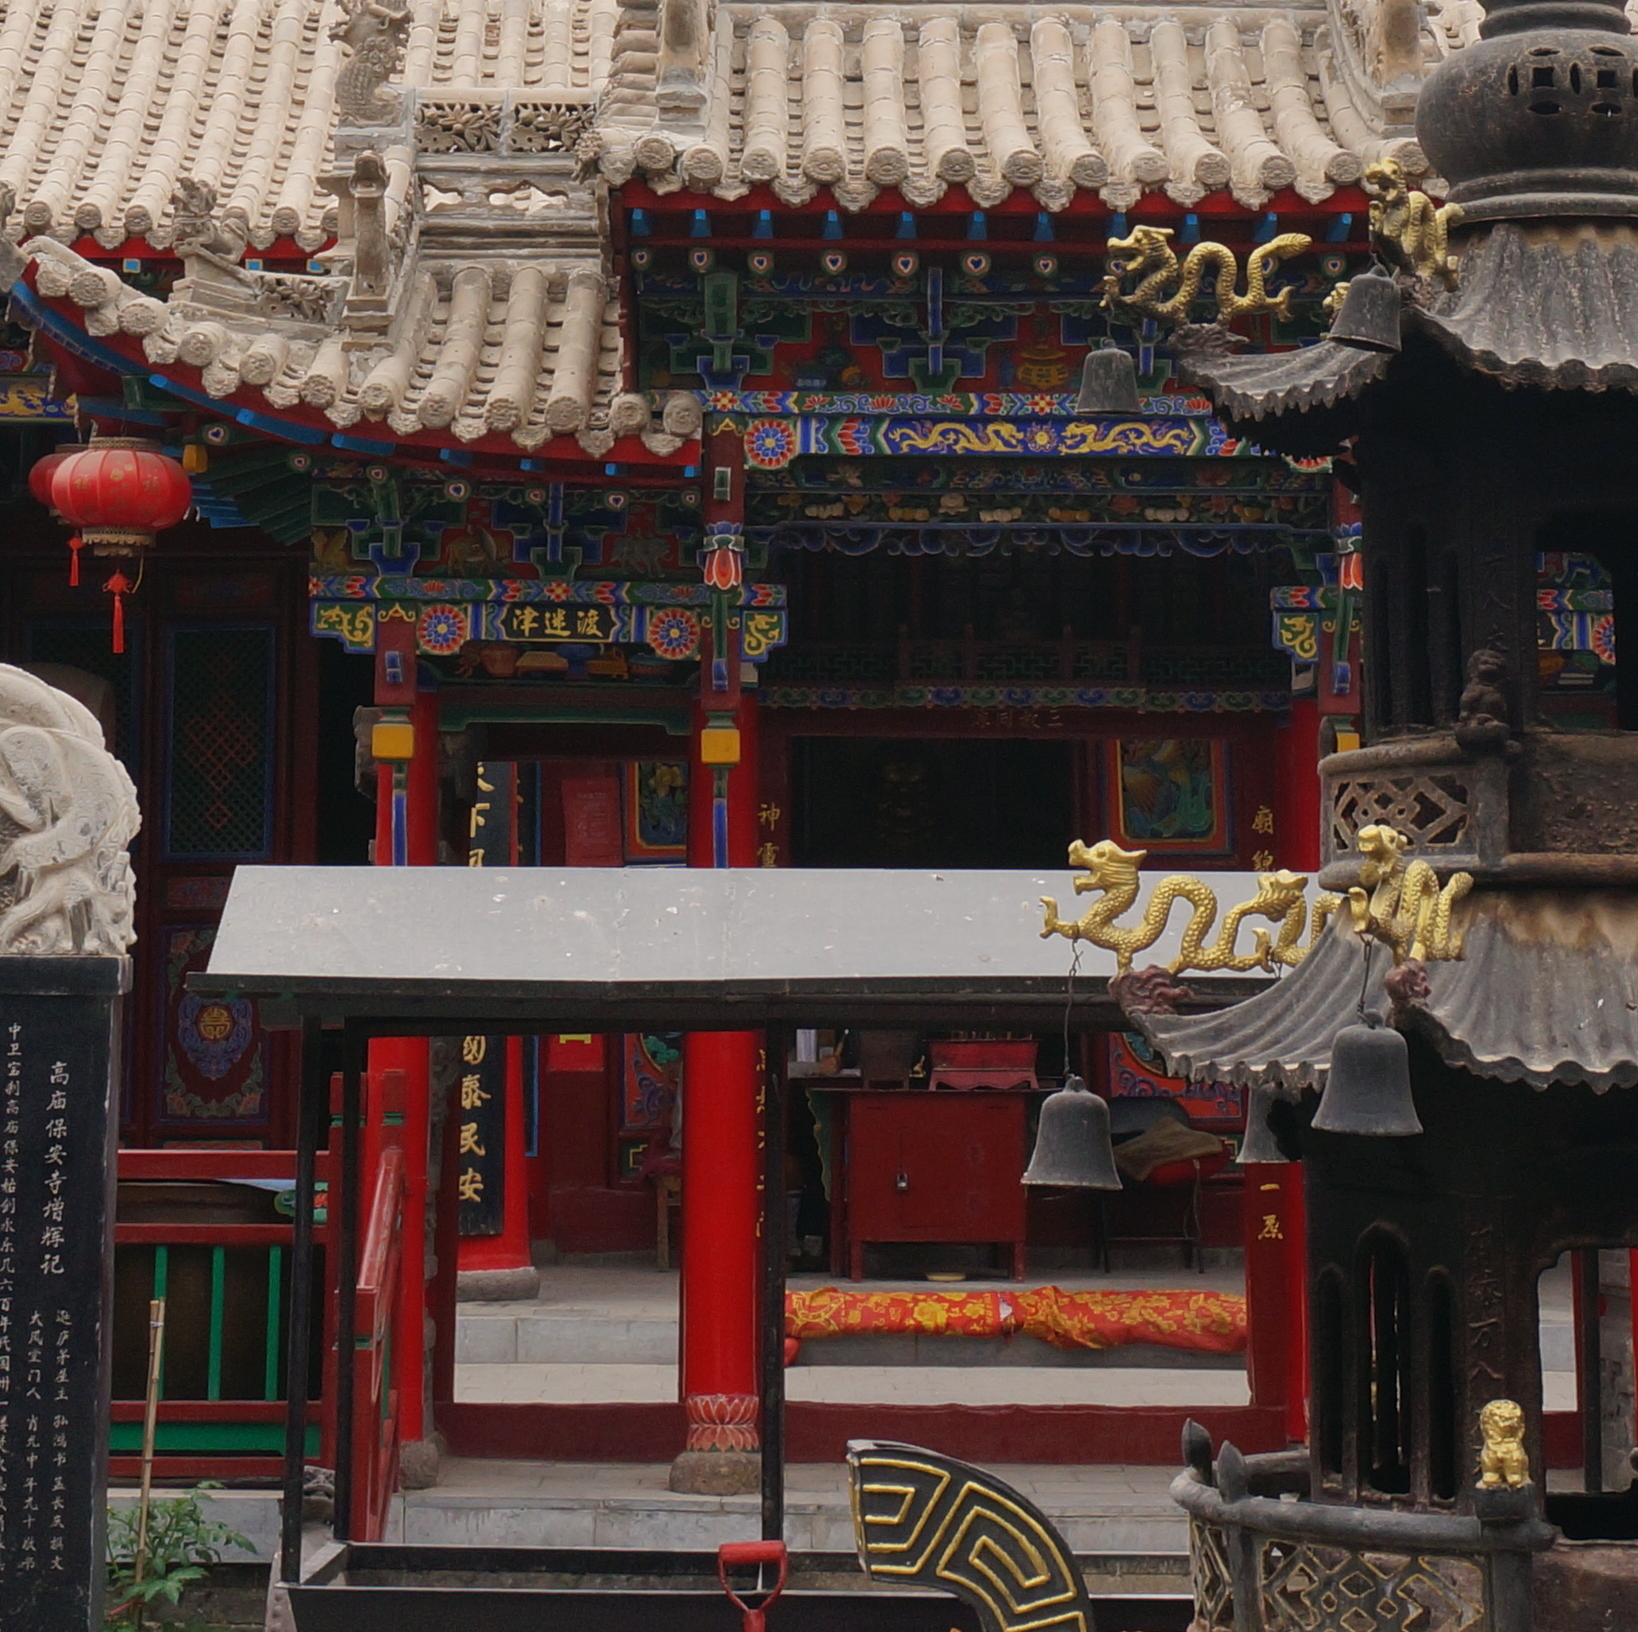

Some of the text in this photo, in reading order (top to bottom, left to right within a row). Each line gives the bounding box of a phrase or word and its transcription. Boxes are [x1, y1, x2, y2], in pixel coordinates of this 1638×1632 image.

[40, 1061, 69, 1274] 高庙保安寺增辉记
